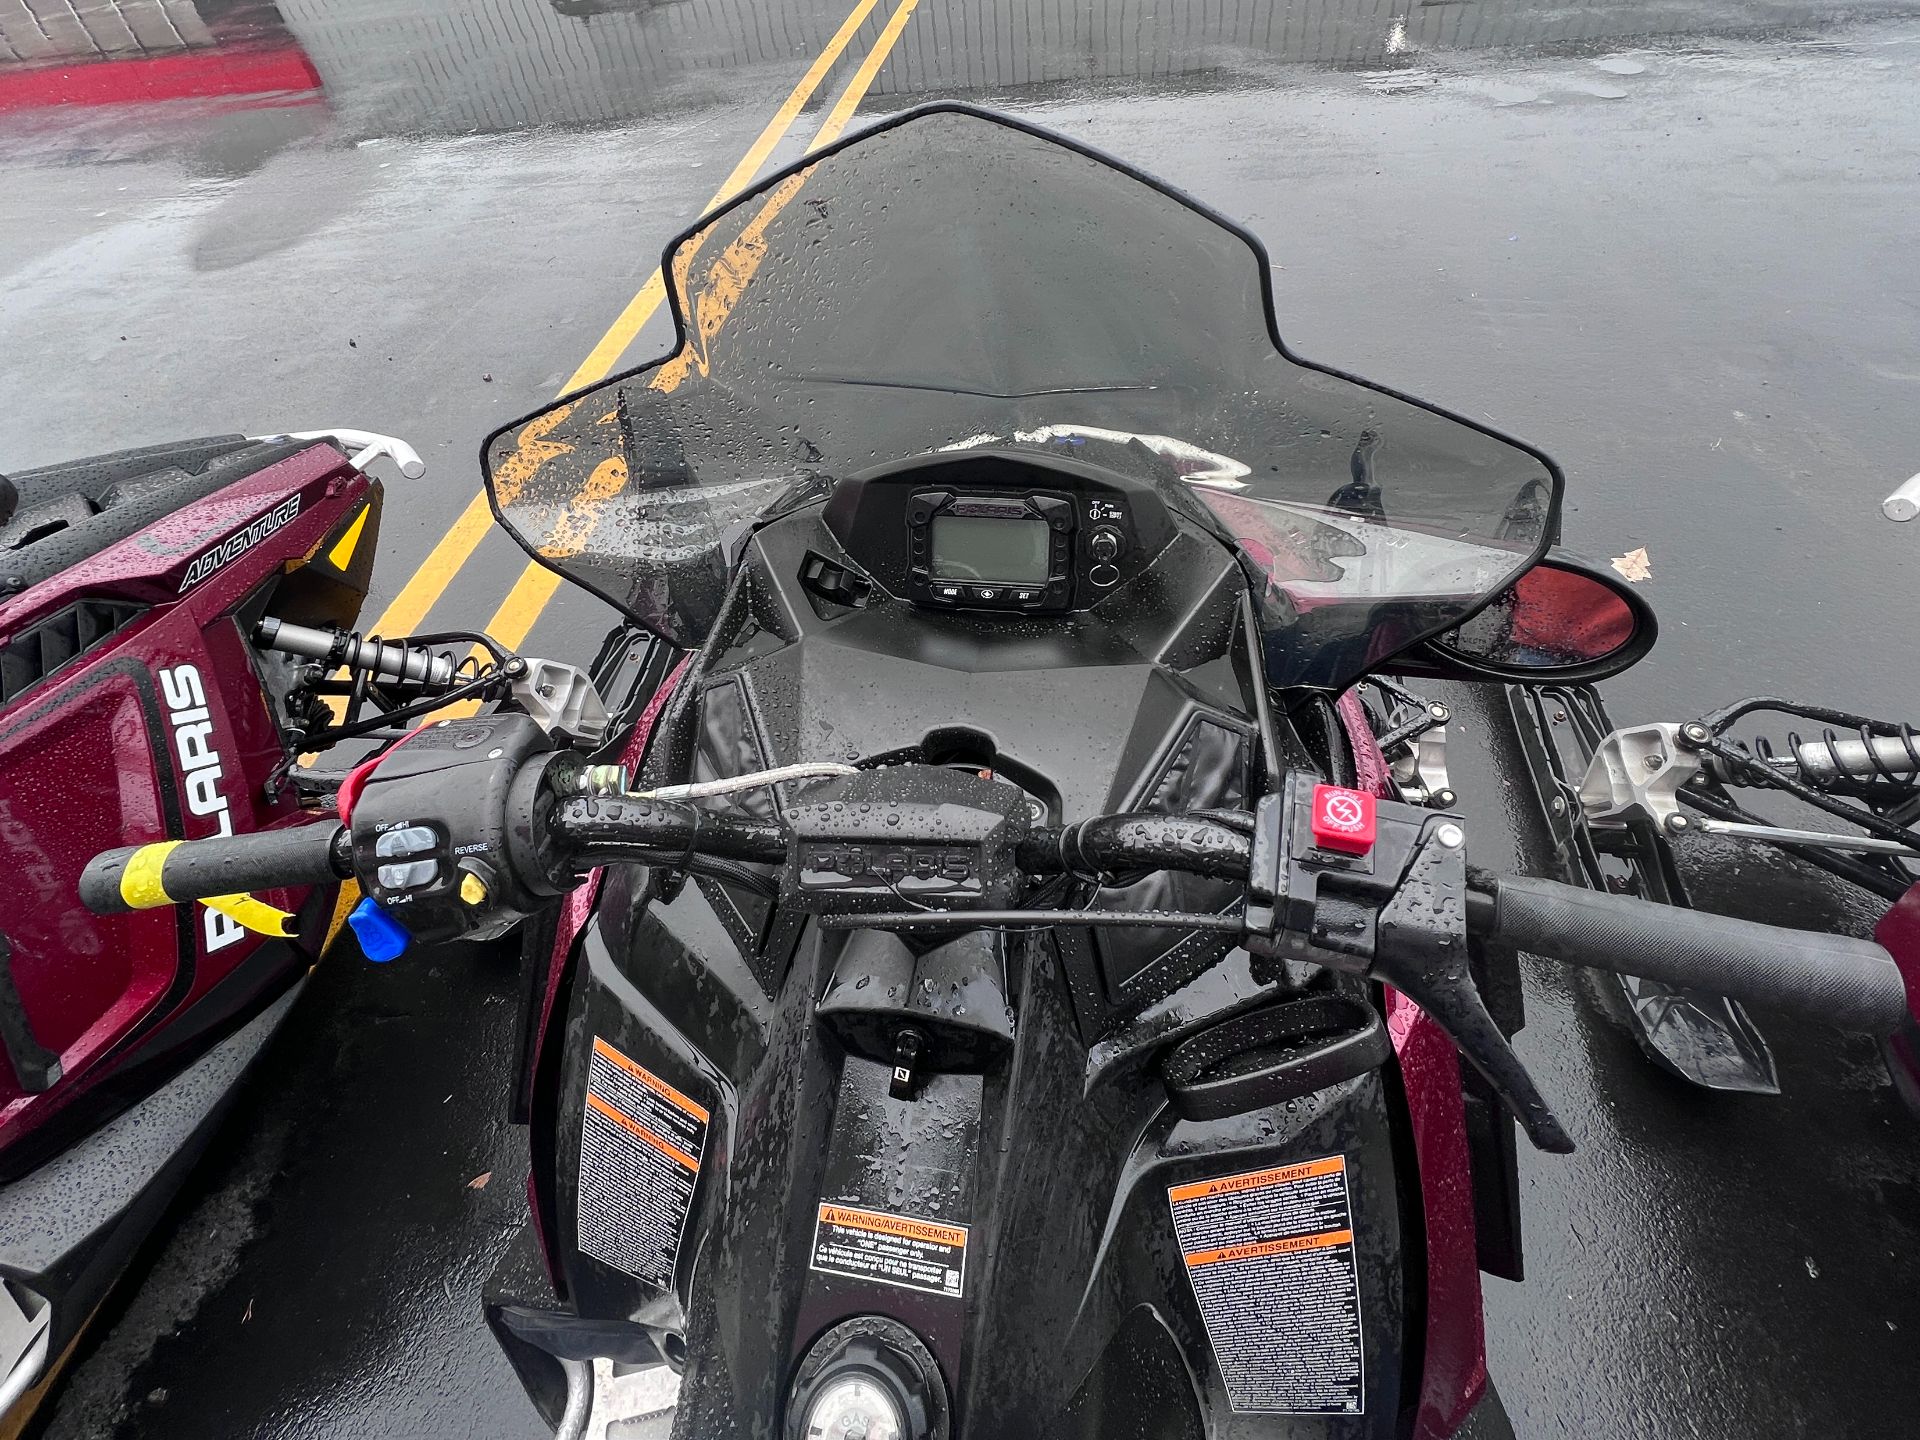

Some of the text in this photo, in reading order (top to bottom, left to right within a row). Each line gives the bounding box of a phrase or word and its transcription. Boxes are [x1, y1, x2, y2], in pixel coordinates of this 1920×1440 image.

[957, 504, 1023, 515] POLARIS
[178, 492, 301, 593] ADVENTURE
[943, 588, 958, 596] MODE
[1323, 790, 1364, 806] RUN-PULL
[159, 664, 246, 953] PLARIS
[375, 820, 410, 833] OFF HI
[1322, 815, 1365, 833] OFF-PUSH
[454, 842, 489, 855] REVERSE
[387, 894, 413, 905] OFF HI
[635, 1069, 671, 1097] WARNING
[628, 1121, 664, 1150] WARNING
[1220, 1166, 1313, 1191] AVERTISSEMENT
[838, 1210, 961, 1242] WARNING/AVERTISSEMENT
[832, 1225, 845, 1235] This
[846, 1228, 867, 1238] vehicle
[874, 1232, 902, 1244] designed
[902, 1237, 912, 1246] for
[912, 1240, 939, 1251] operator
[939, 1245, 952, 1254] and
[857, 1239, 877, 1249] "ONE"
[878, 1243, 910, 1255] passenger
[1228, 1237, 1320, 1258] AVERTISSEMENT
[816, 1253, 828, 1263] que
[835, 1256, 870, 1270] conducteur
[819, 1244, 828, 1253] Ce
[854, 1252, 864, 1260] est
[884, 1258, 900, 1267] pour
[899, 1261, 908, 1269] ne
[908, 1261, 943, 1275] transporter
[841, 1412, 869, 1427] GAS
